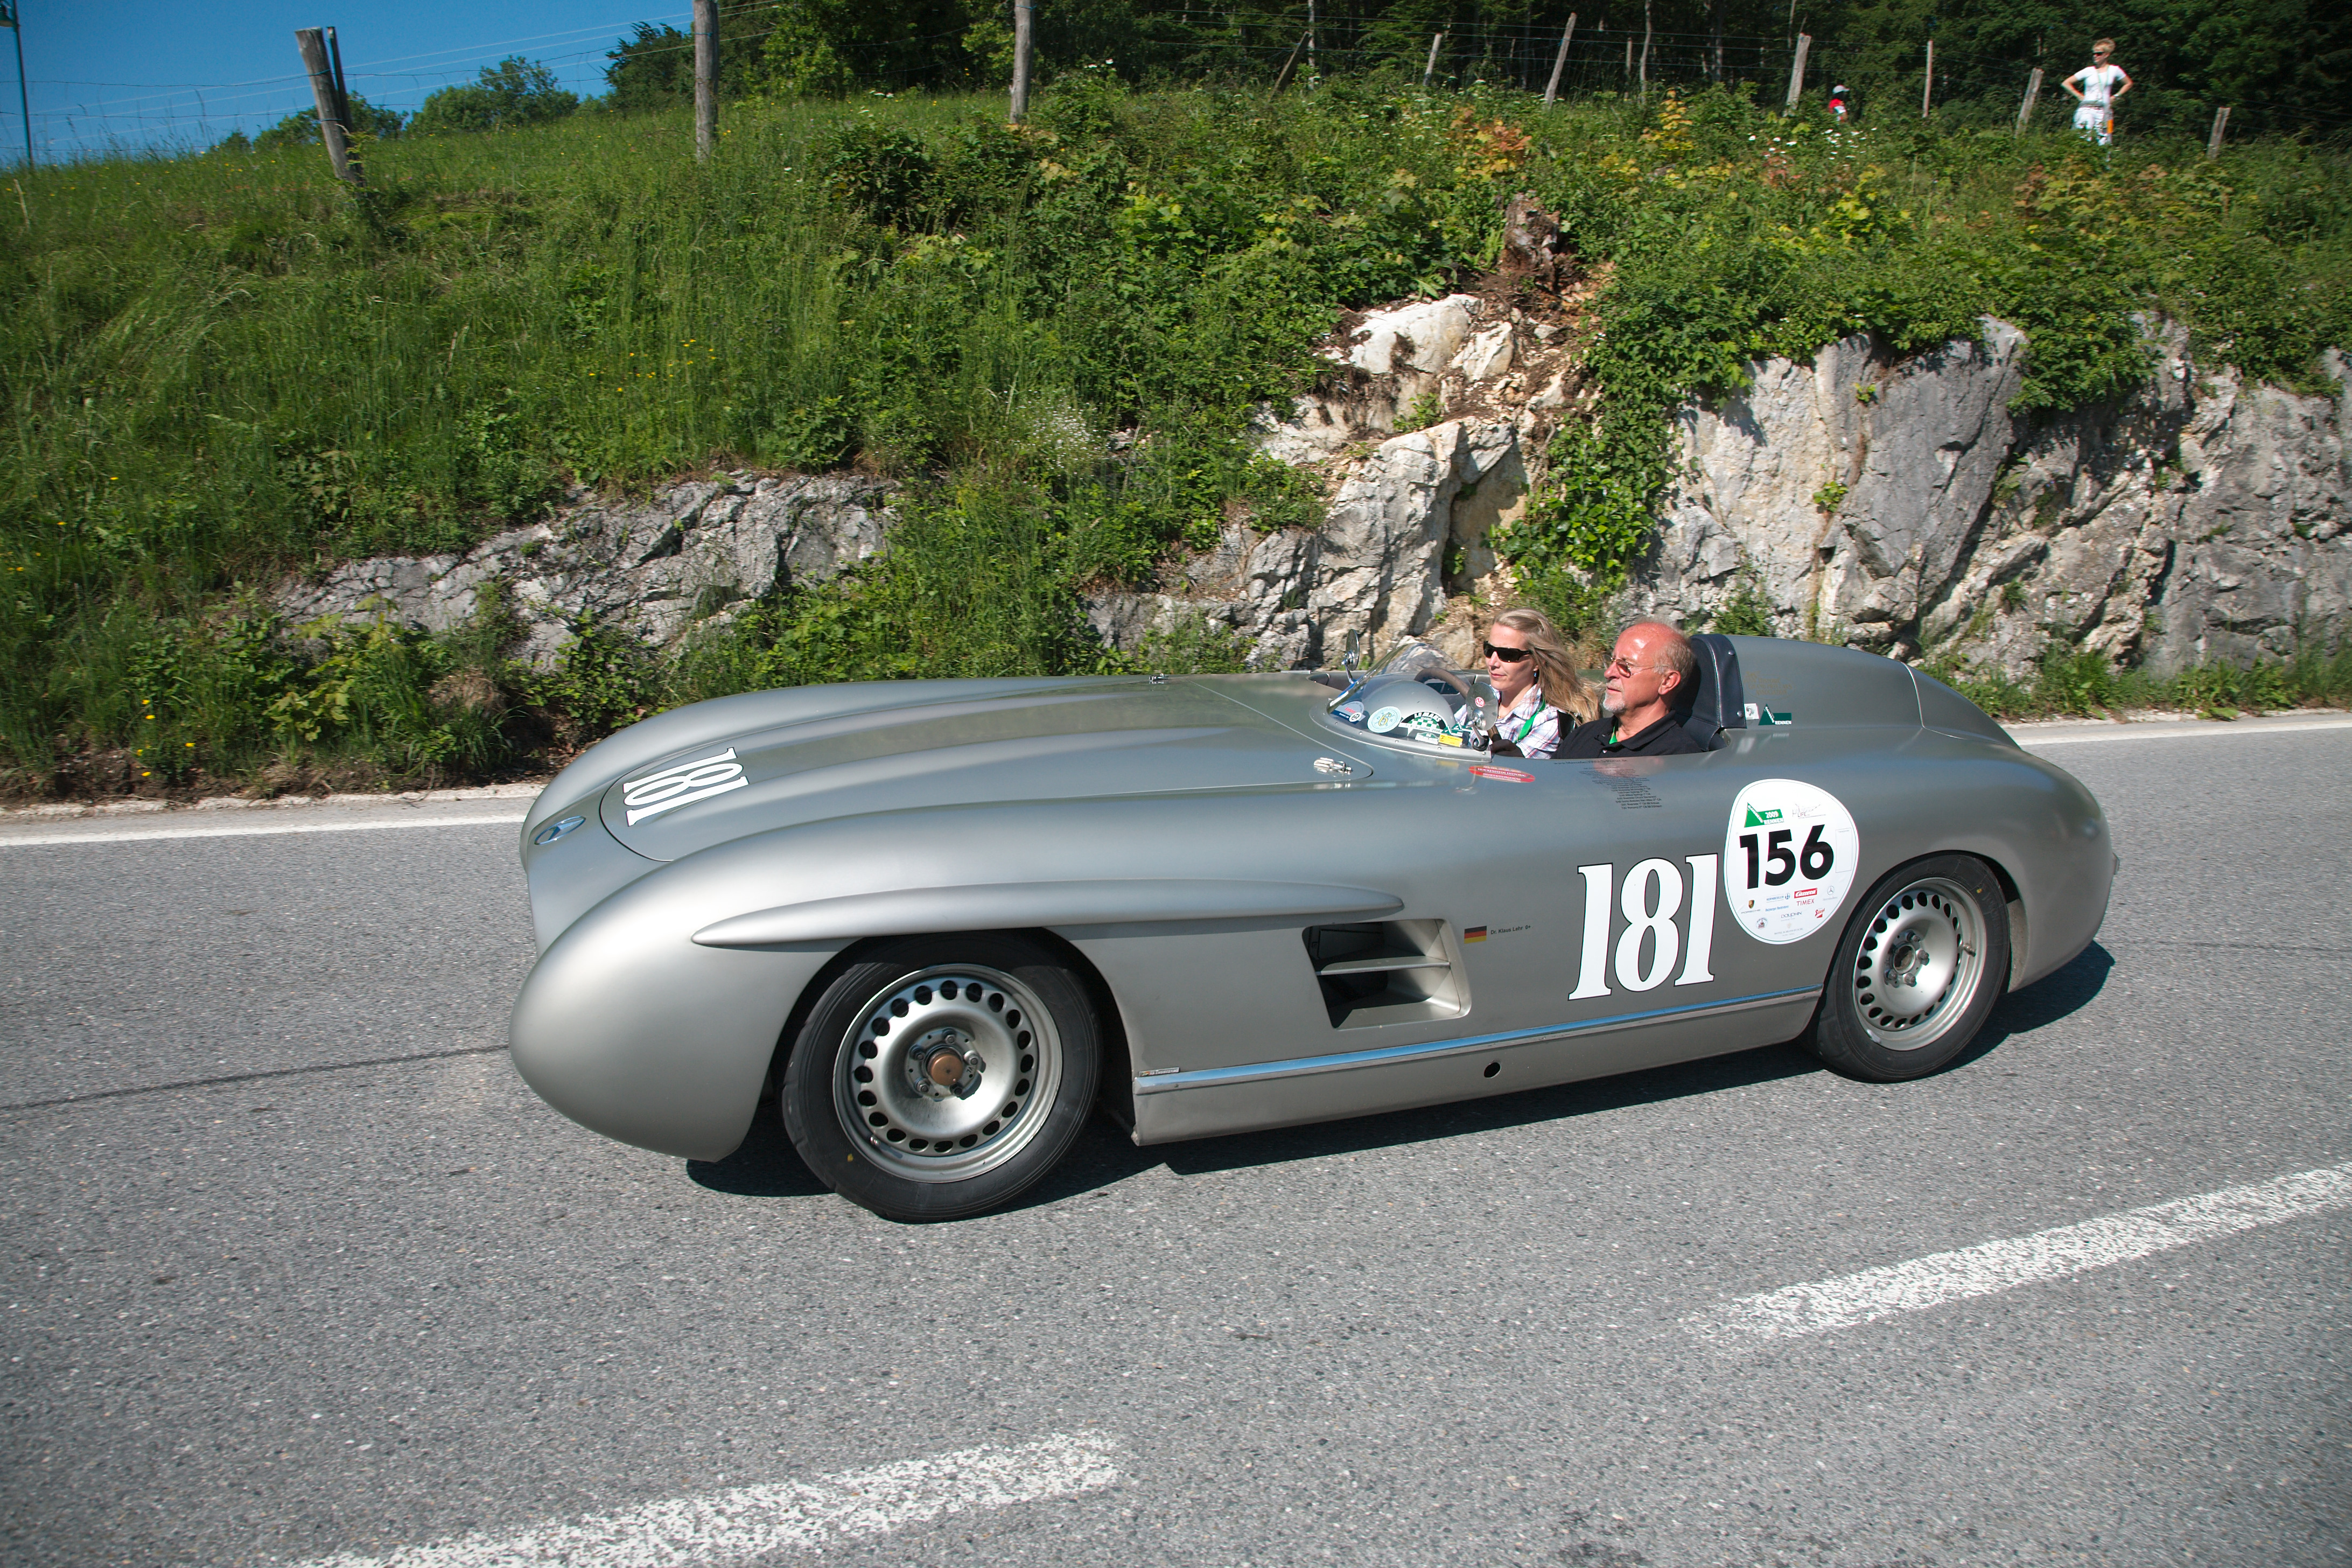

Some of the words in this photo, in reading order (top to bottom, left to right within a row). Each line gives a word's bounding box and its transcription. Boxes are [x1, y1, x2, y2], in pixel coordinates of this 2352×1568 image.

[623, 747, 750, 827] 181
[1739, 824, 1834, 890] 156
[1568, 852, 1718, 1002] 181
[1795, 890, 1816, 898] Carrera
